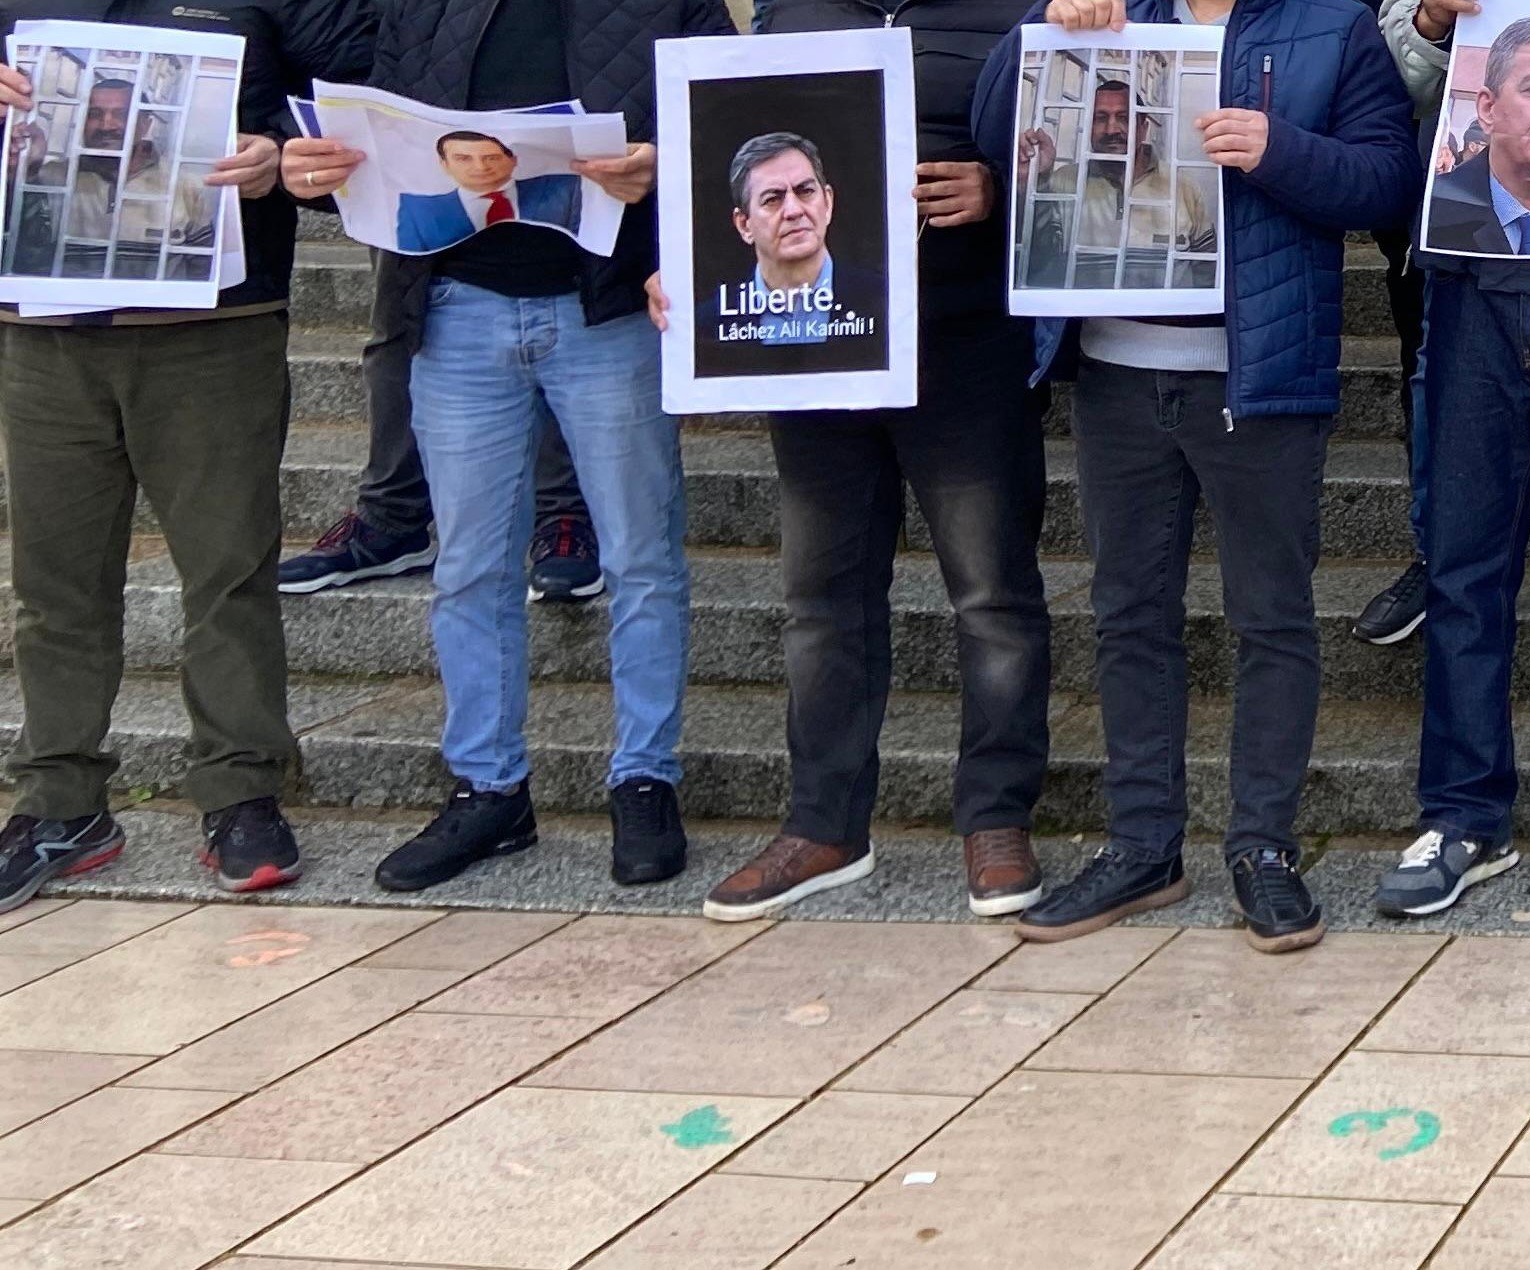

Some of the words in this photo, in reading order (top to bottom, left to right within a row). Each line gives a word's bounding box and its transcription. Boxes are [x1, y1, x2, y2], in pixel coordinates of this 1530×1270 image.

[719, 278, 842, 316] Liberté.
[719, 323, 775, 341] Lâchez
[779, 320, 801, 338] Ali
[805, 317, 865, 337] Karimli
